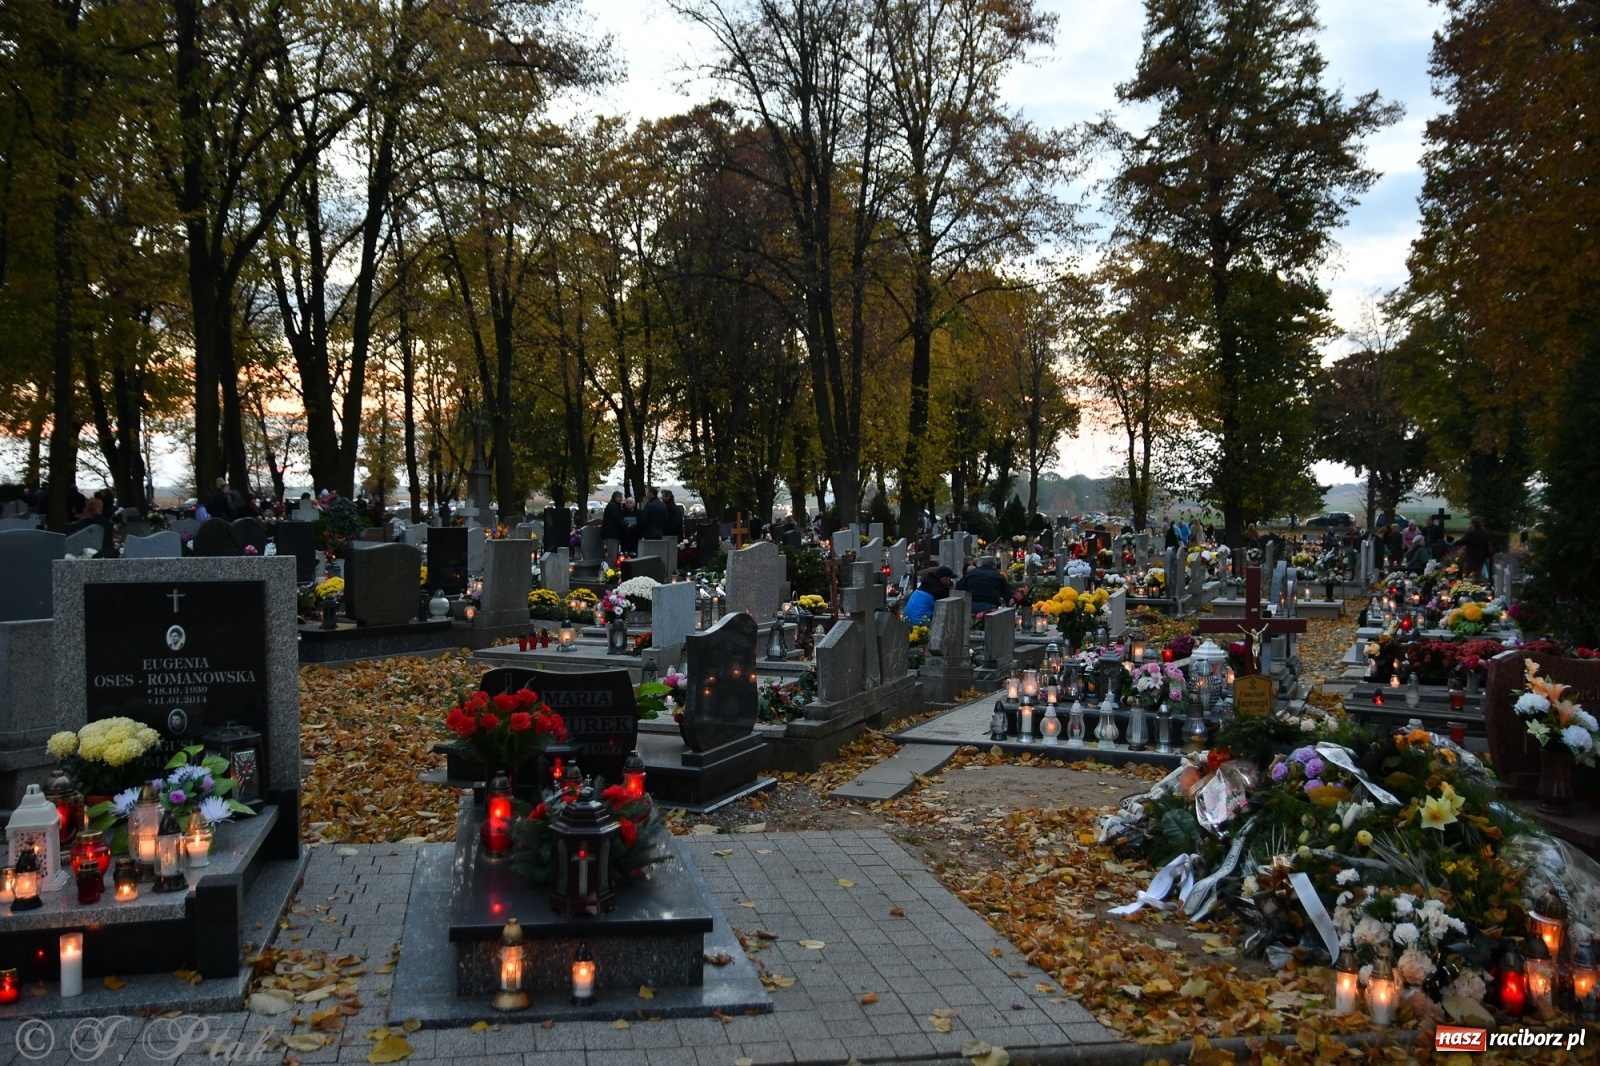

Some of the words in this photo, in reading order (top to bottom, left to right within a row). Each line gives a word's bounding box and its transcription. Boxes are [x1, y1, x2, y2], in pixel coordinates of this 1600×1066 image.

[142, 657, 210, 671] EUGENIA
[94, 674, 135, 687] OSES
[147, 670, 257, 685] ROMANOWSKA
[544, 692, 610, 705] MARIA
[587, 744, 620, 754] 1997
